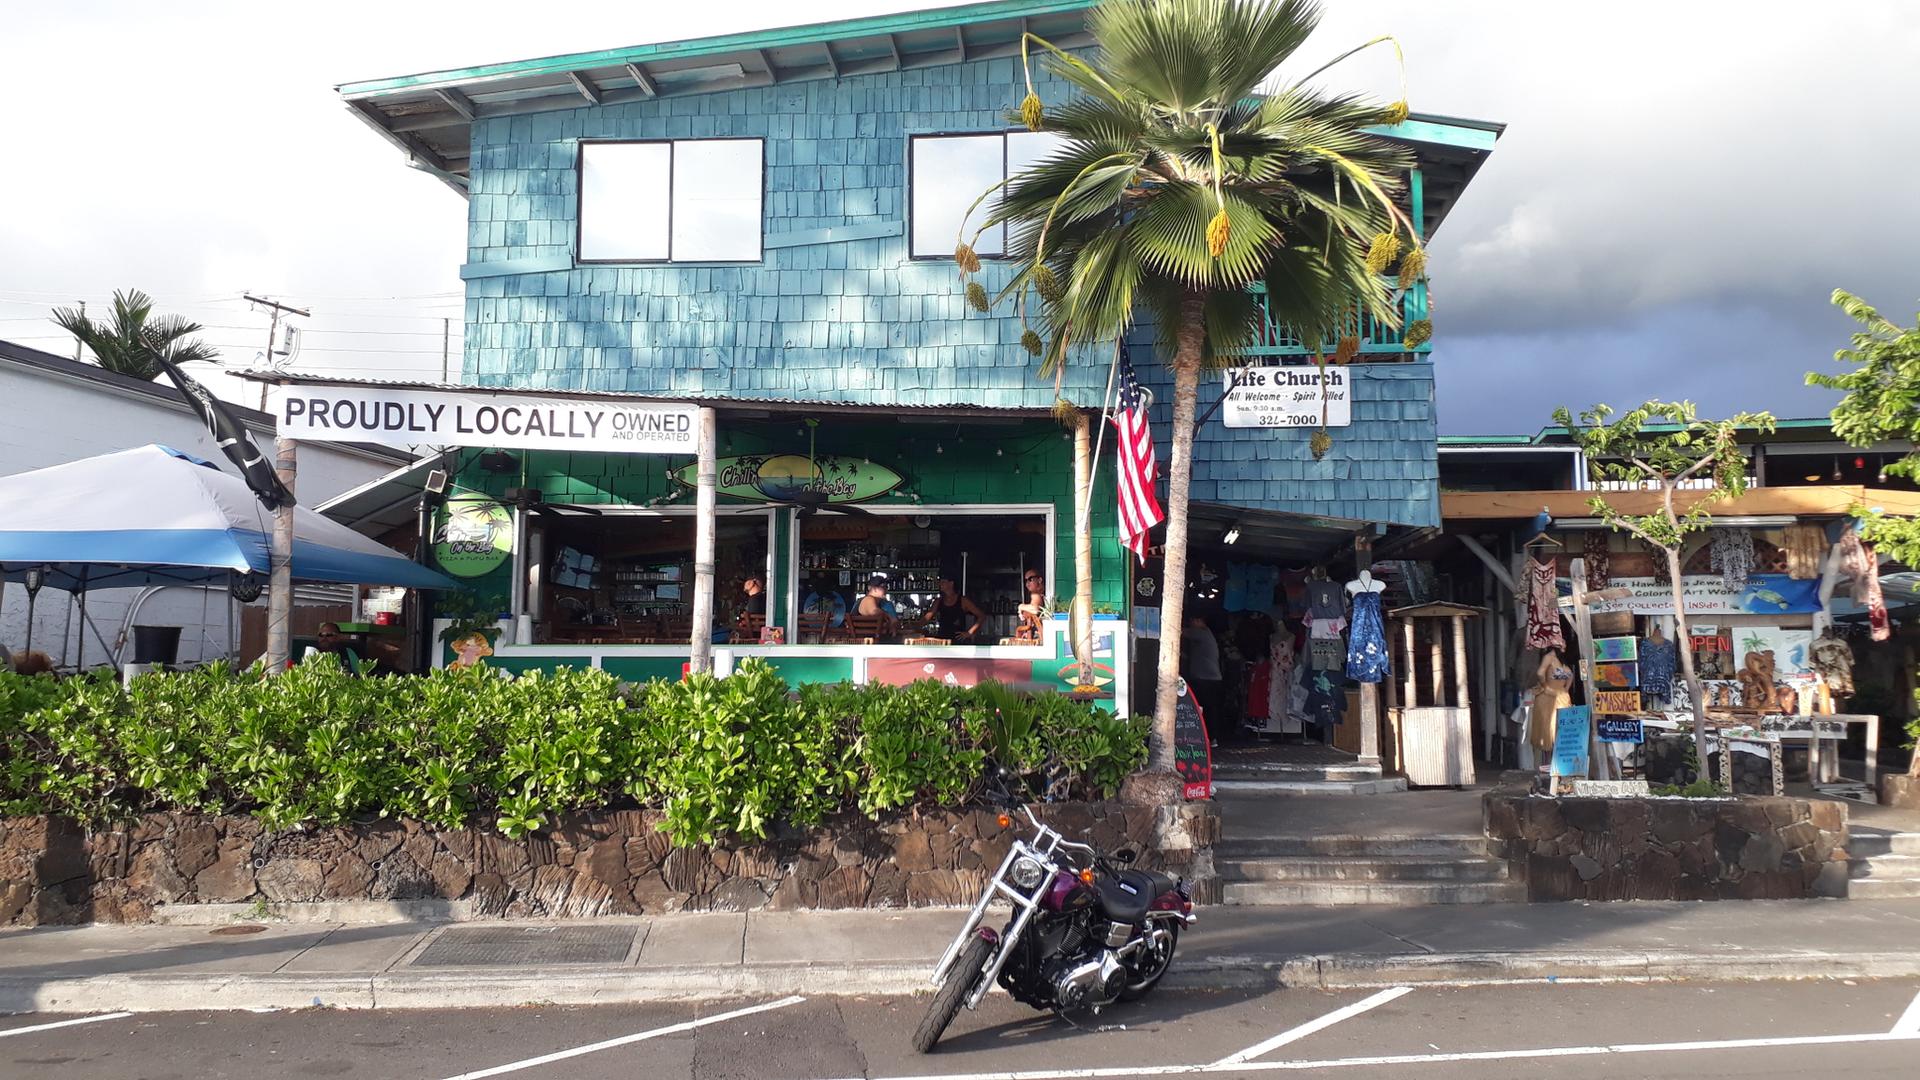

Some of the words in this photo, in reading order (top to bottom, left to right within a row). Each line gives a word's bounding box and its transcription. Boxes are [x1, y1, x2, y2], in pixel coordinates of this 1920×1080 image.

[1230, 371, 1266, 386] Life
[1273, 370, 1343, 386] Church
[1228, 391, 1240, 402] All
[1245, 391, 1281, 401] Welcome
[1292, 391, 1316, 403] Spirit
[285, 398, 446, 432] PROUDLY
[456, 405, 604, 438] LOCALLY
[612, 412, 691, 432] OWNED
[612, 431, 635, 441] AND
[636, 432, 691, 442] OPERATED
[1684, 588, 1703, 597] Art
[1599, 692, 1639, 713] MASSAGE
[1606, 720, 1639, 732] GALLERY
